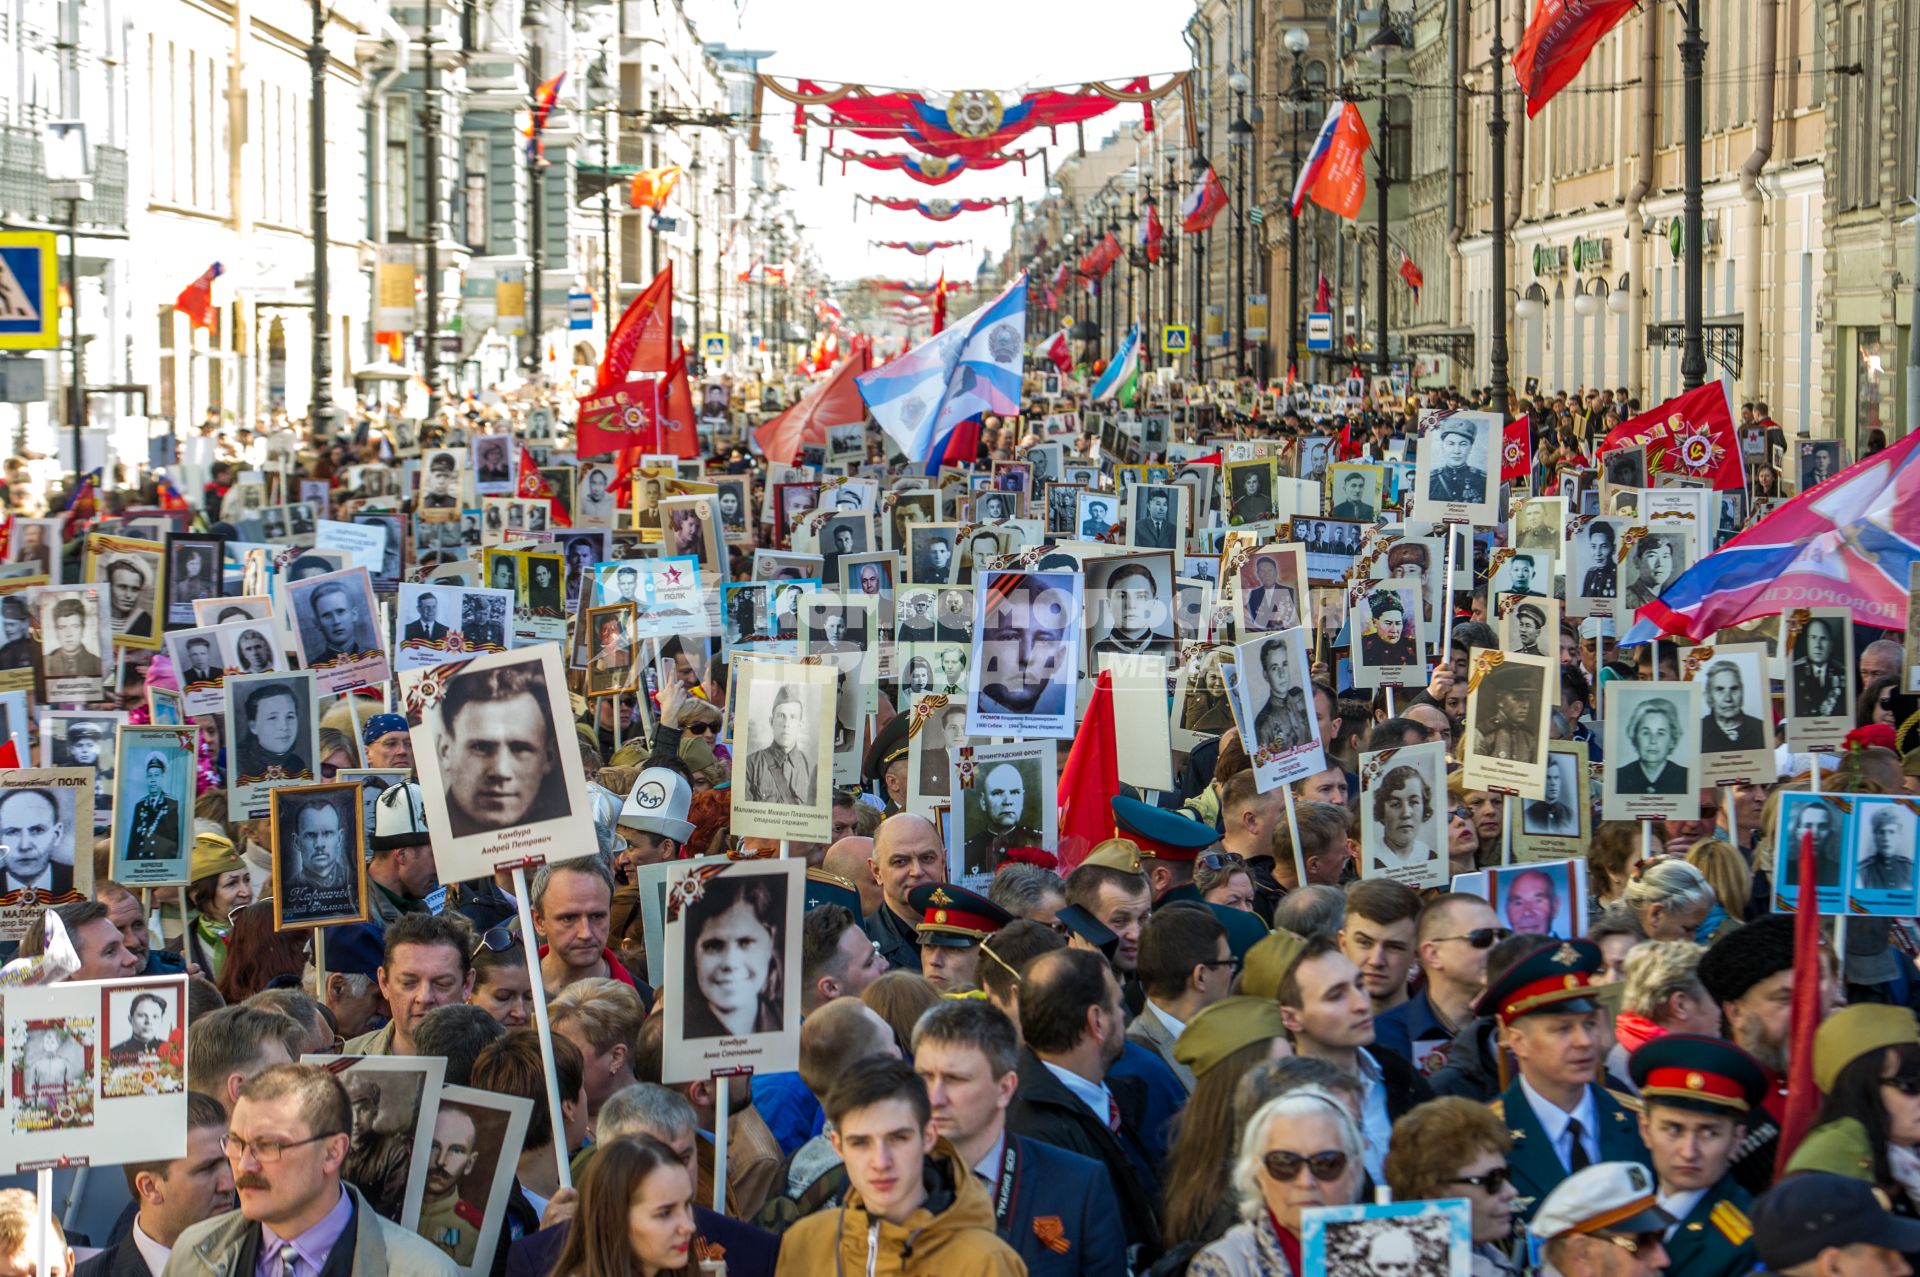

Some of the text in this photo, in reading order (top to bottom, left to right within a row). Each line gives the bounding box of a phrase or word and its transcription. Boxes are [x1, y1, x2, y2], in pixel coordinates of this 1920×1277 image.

[664, 592, 687, 600] ПОЛК
[977, 751, 1023, 760] ЛЕНИНГРАДСКИЙ
[58, 777, 87, 786] ПОЛК
[767, 808, 789, 817] Михаил
[790, 810, 829, 820] Платонович
[753, 817, 809, 827] старший сержант
[497, 828, 531, 841] Камбура
[481, 835, 552, 855] Андрей Петрович
[718, 1039, 748, 1048] Камбура
[703, 1048, 763, 1059] Анна Степановна
[997, 1148, 1016, 1218] EOS DIGITAL
